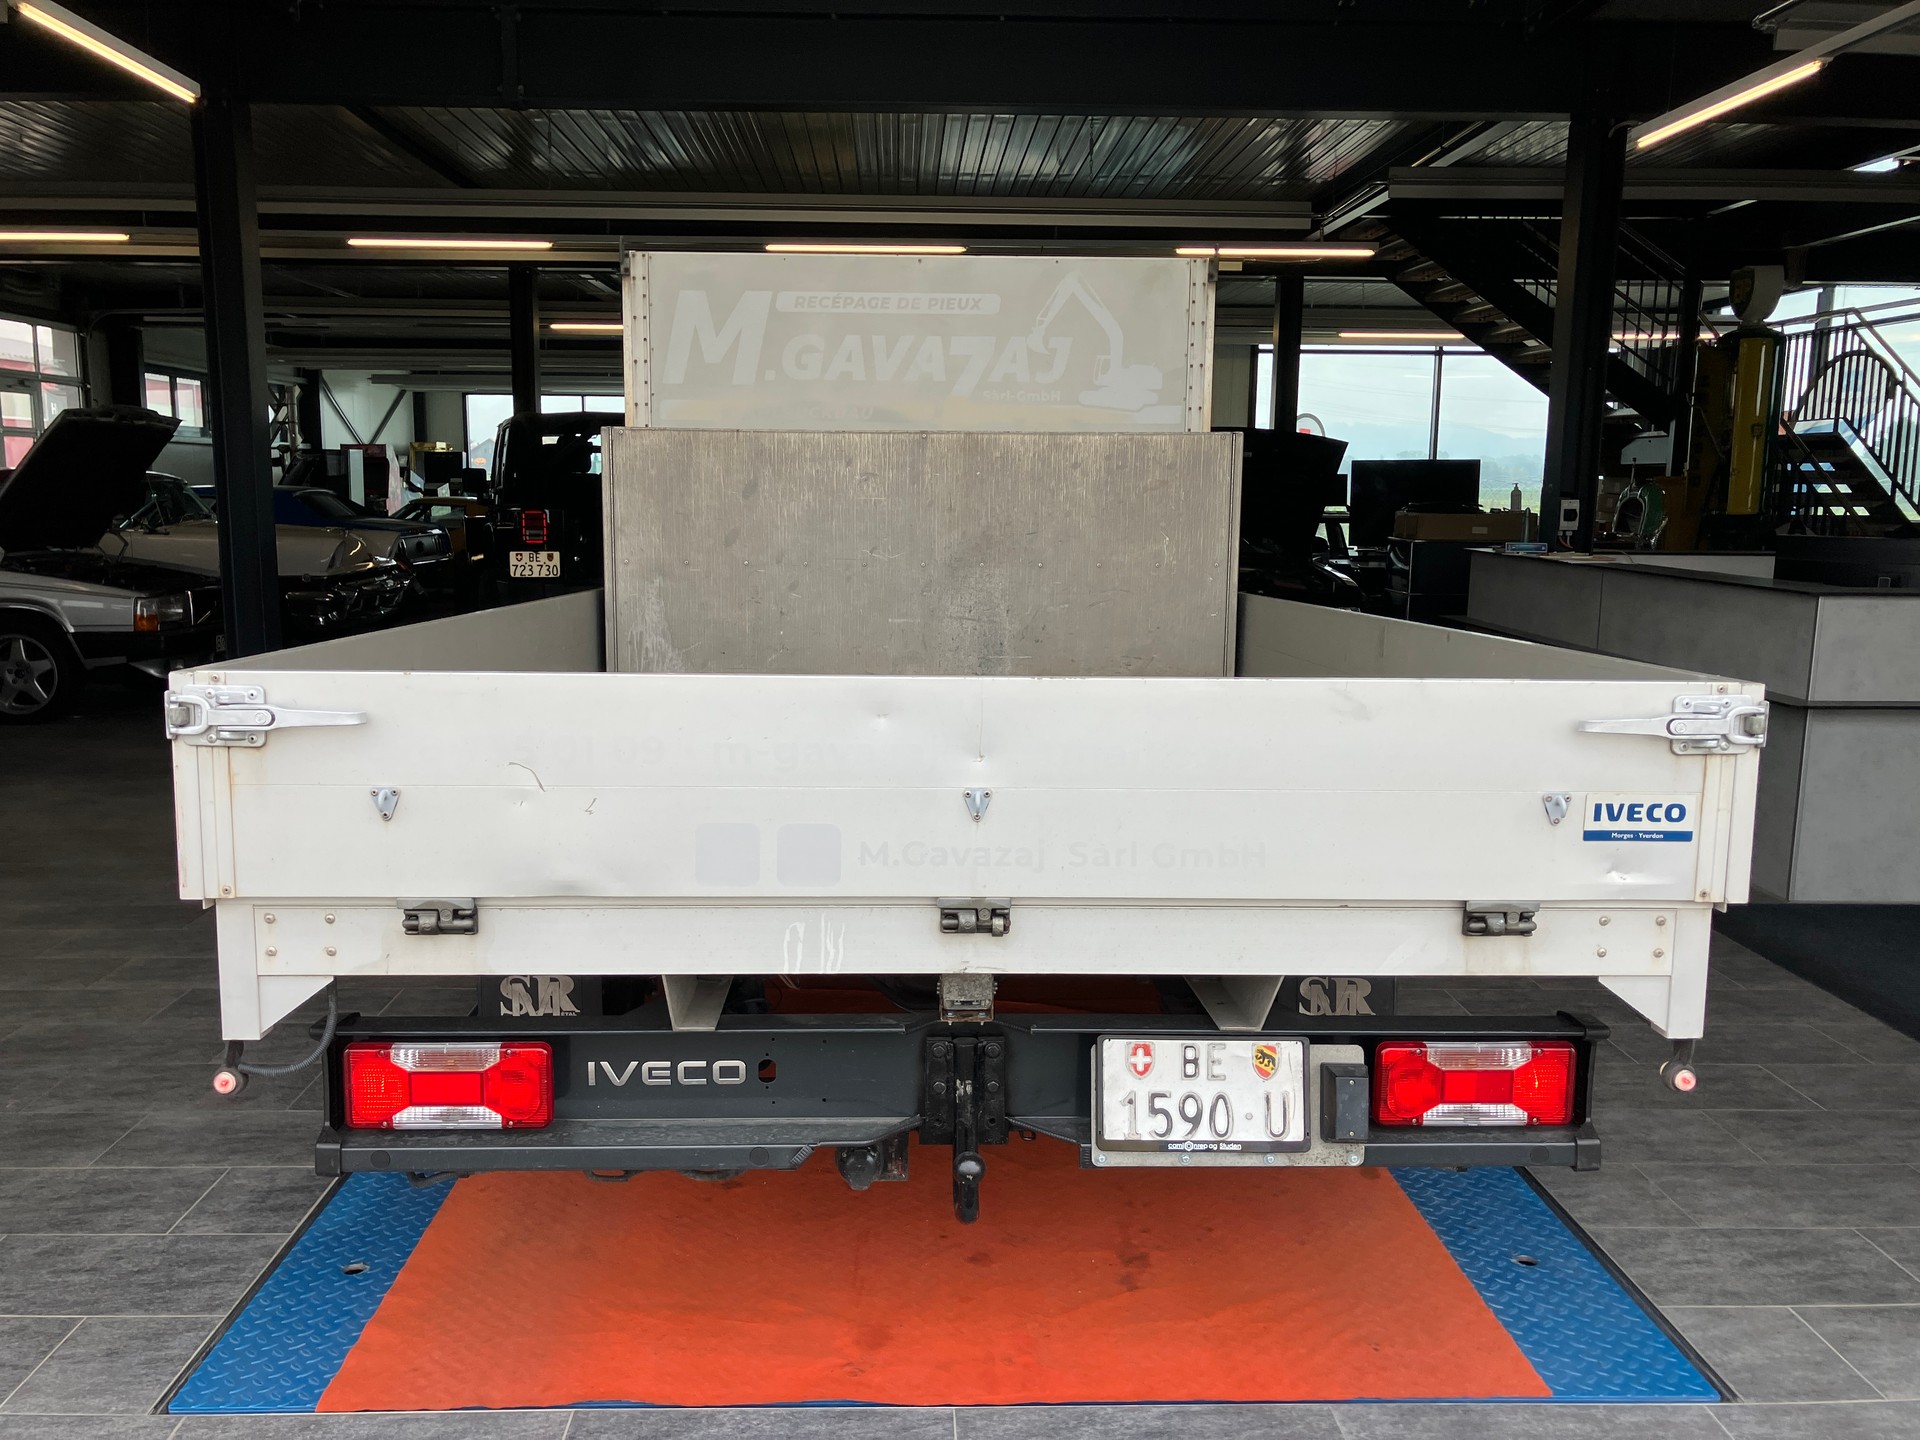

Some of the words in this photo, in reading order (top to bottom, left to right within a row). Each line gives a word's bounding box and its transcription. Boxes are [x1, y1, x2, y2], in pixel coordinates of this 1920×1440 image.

[794, 292, 893, 312] RECÉPAGE
[897, 296, 922, 312] DE
[928, 296, 983, 313] PIEUX
[528, 552, 541, 563] BE
[511, 564, 534, 577] 723
[536, 564, 559, 577] 730
[1593, 802, 1687, 823] IVECO
[1611, 832, 1634, 840] Morges
[858, 839, 1045, 873] M.Gavazaj
[1152, 839, 1266, 869] GmbH
[1181, 1043, 1227, 1080] BE
[587, 1060, 747, 1086] IVECO
[1119, 1090, 1234, 1141] 1590
[1263, 1090, 1290, 1142] U
